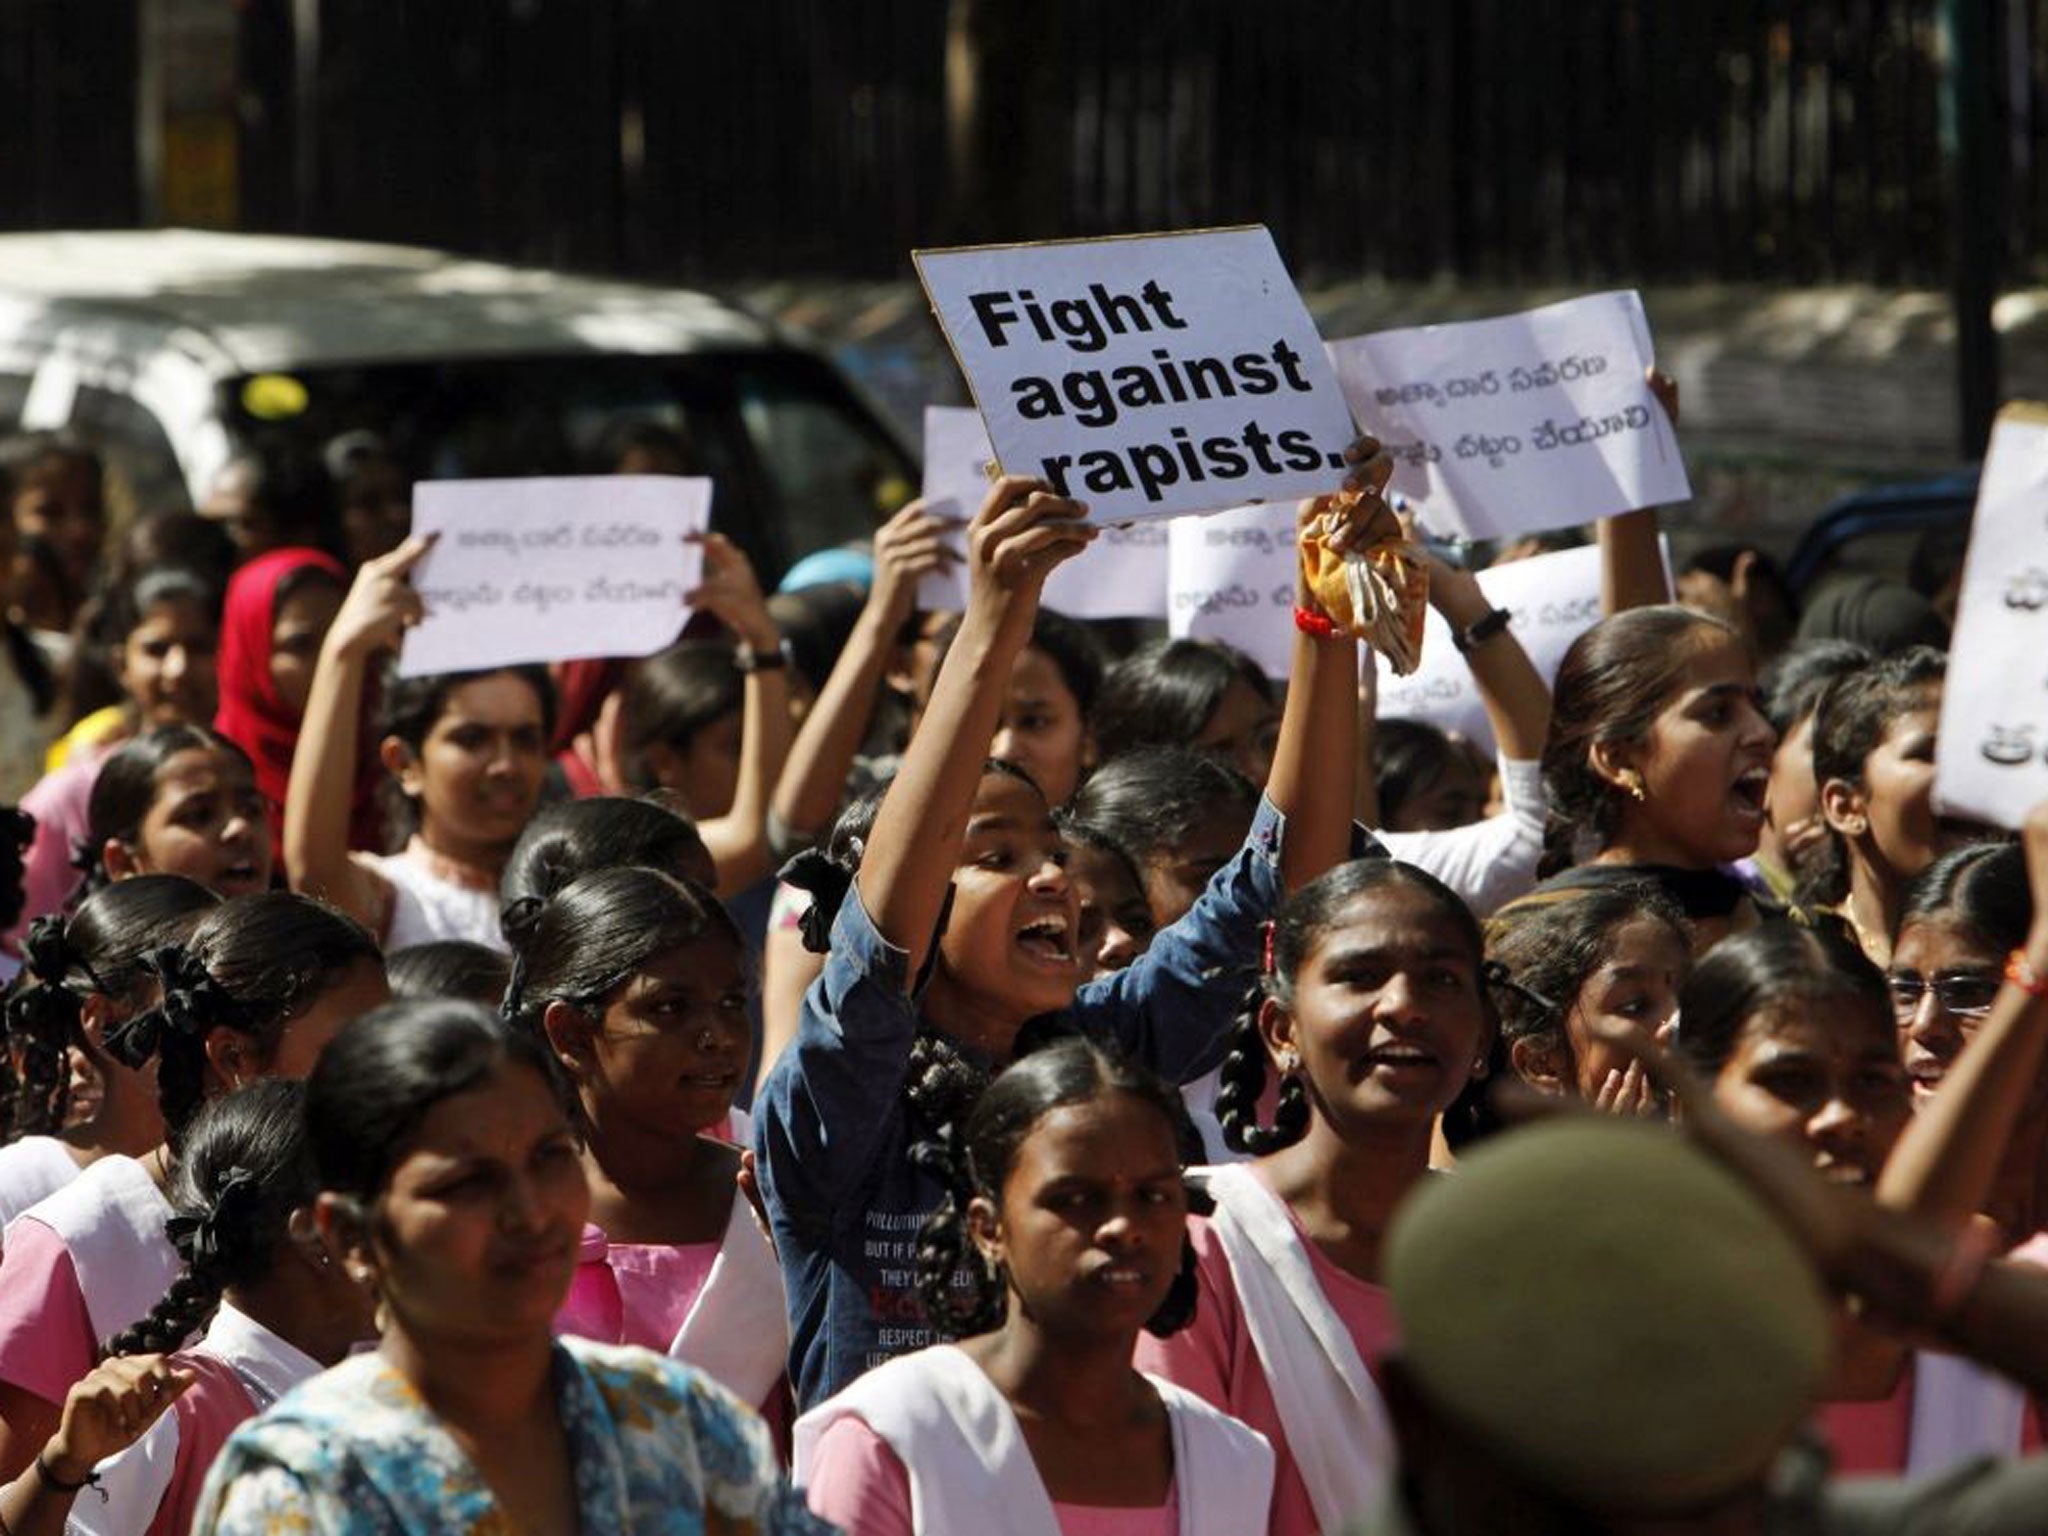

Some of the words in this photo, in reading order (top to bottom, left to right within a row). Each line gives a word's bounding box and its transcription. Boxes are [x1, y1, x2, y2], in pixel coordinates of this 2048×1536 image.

[968, 279, 1188, 352] Fight
[1011, 339, 1313, 428] against
[1042, 420, 1346, 502] rapists.
[880, 1268, 914, 1287] THEY
[878, 1328, 931, 1347] RESPECT
